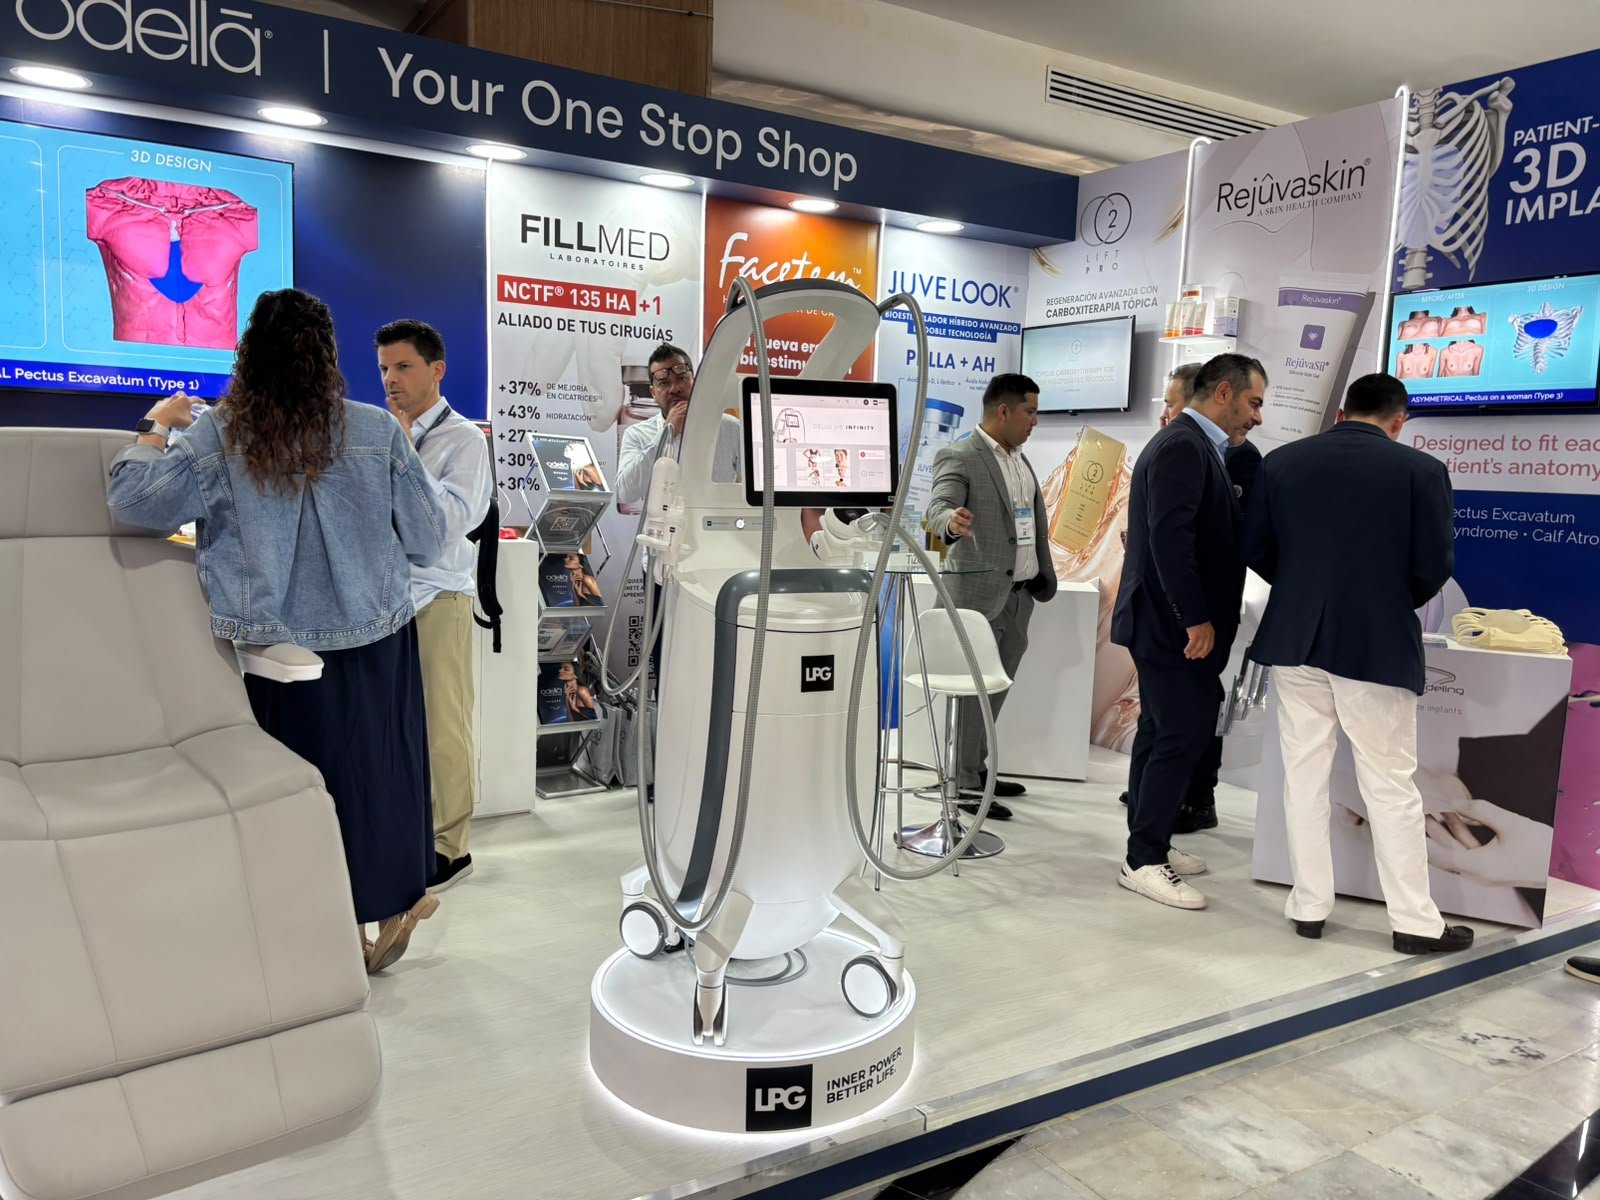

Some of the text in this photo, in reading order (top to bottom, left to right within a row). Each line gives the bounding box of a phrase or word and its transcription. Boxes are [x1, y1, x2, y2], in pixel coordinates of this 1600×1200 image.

[377, 47, 858, 190] Your One Stop Shop
[130, 149, 212, 173] 3D DESIGN
[1509, 142, 1587, 194] 3D
[1258, 191, 1363, 217] A SKIN HEALTH COMPANY
[521, 213, 670, 261] FILLMED
[550, 253, 644, 271] LABORATOIRES
[1086, 250, 1120, 263] LIFT
[1085, 262, 1119, 275] PRO
[504, 281, 564, 302] NCTF®
[570, 288, 600, 308] 135
[606, 292, 631, 311] HA
[1046, 285, 1158, 306] REGENERACIÓN AVANZADA CON
[1527, 282, 1565, 292] 3D DESIGN
[1045, 297, 1158, 319] CARBOXITERAPIA TÓPICA
[497, 312, 673, 341] ALIADO DE TUS CIRUGÍAS
[948, 329, 992, 341] TECNOLOGÍA
[949, 317, 977, 328] HÍBRIDO
[979, 322, 1018, 333] AVANZADO
[906, 349, 955, 369] PLLA
[972, 356, 995, 373] AH
[15, 368, 64, 382] Pectus
[68, 371, 144, 387] Excavatum
[148, 376, 185, 391] (Type
[188, 379, 200, 390] 1)
[558, 383, 588, 392] MEJORÍA
[1465, 393, 1488, 401] Pectus
[1534, 392, 1554, 401] (Type
[1556, 392, 1564, 400] 3)
[1413, 434, 1505, 455] Designed
[1512, 435, 1532, 451] to
[1539, 434, 1558, 451] fit
[1446, 457, 1600, 482] tient's anatomy
[1453, 506, 1575, 524] ectus Excavatum
[1453, 525, 1519, 540] yndrome
[1532, 529, 1564, 543] Calf
[805, 666, 832, 682] LPG
[1425, 684, 1465, 696] deling
[1427, 705, 1463, 715] implants
[827, 1069, 866, 1092] INNER
[754, 1085, 807, 1112] LPG
[827, 1079, 873, 1104] BETTER
